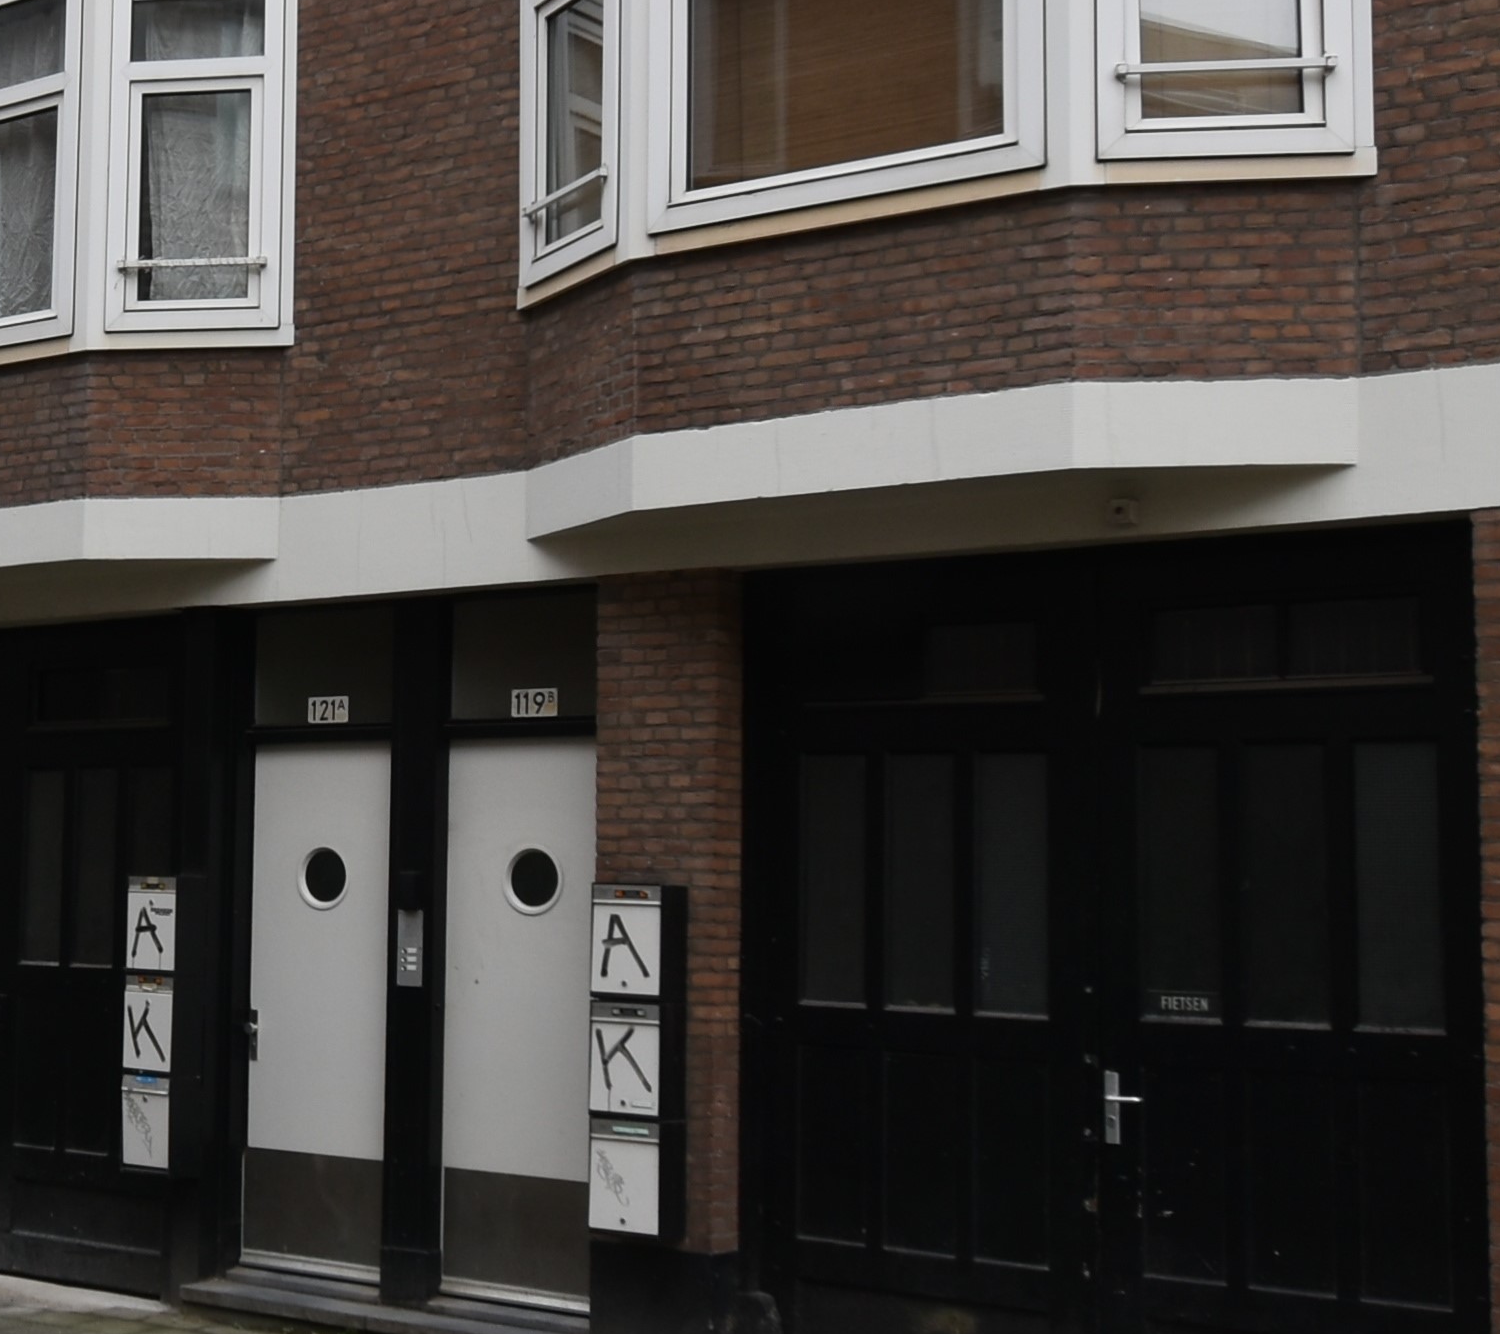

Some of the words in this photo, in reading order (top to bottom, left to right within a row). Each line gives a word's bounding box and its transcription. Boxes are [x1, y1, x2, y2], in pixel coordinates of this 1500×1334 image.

[131, 906, 164, 958] A
[600, 913, 650, 978] A
[1160, 996, 1209, 1012] FIETSEN
